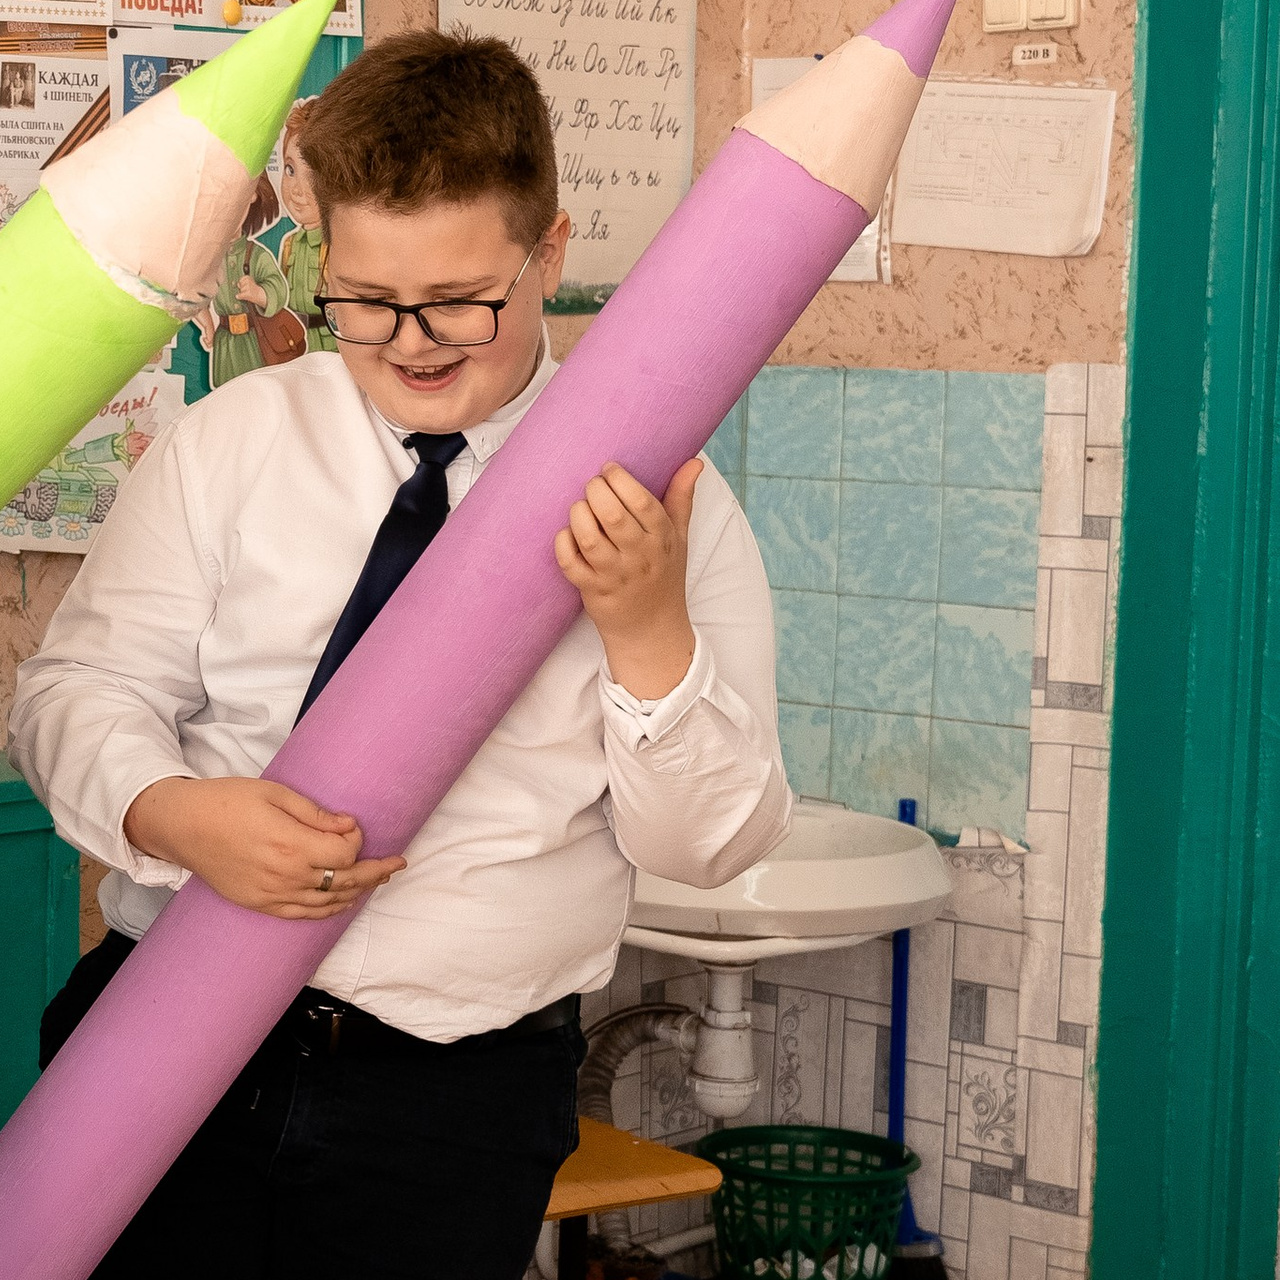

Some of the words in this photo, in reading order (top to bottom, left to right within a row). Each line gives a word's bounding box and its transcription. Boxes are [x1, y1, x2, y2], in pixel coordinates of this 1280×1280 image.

[546, 39, 578, 71] Нн
[583, 42, 608, 74] Оо
[613, 44, 648, 78] Пп
[654, 48, 683, 92] Рр
[1021, 49, 1038, 60] 220
[38, 70, 99, 87] КАЖДАЯ
[42, 90, 49, 101] 4
[50, 90, 94, 103] ШИНЕЛЬ
[21, 120, 52, 131] СШИТА
[53, 122, 65, 132] НА
[569, 98, 599, 141] Фф
[605, 99, 643, 131] Хх
[650, 102, 682, 141] Цц
[561, 153, 605, 192] Щщ
[582, 209, 610, 240] Яя
